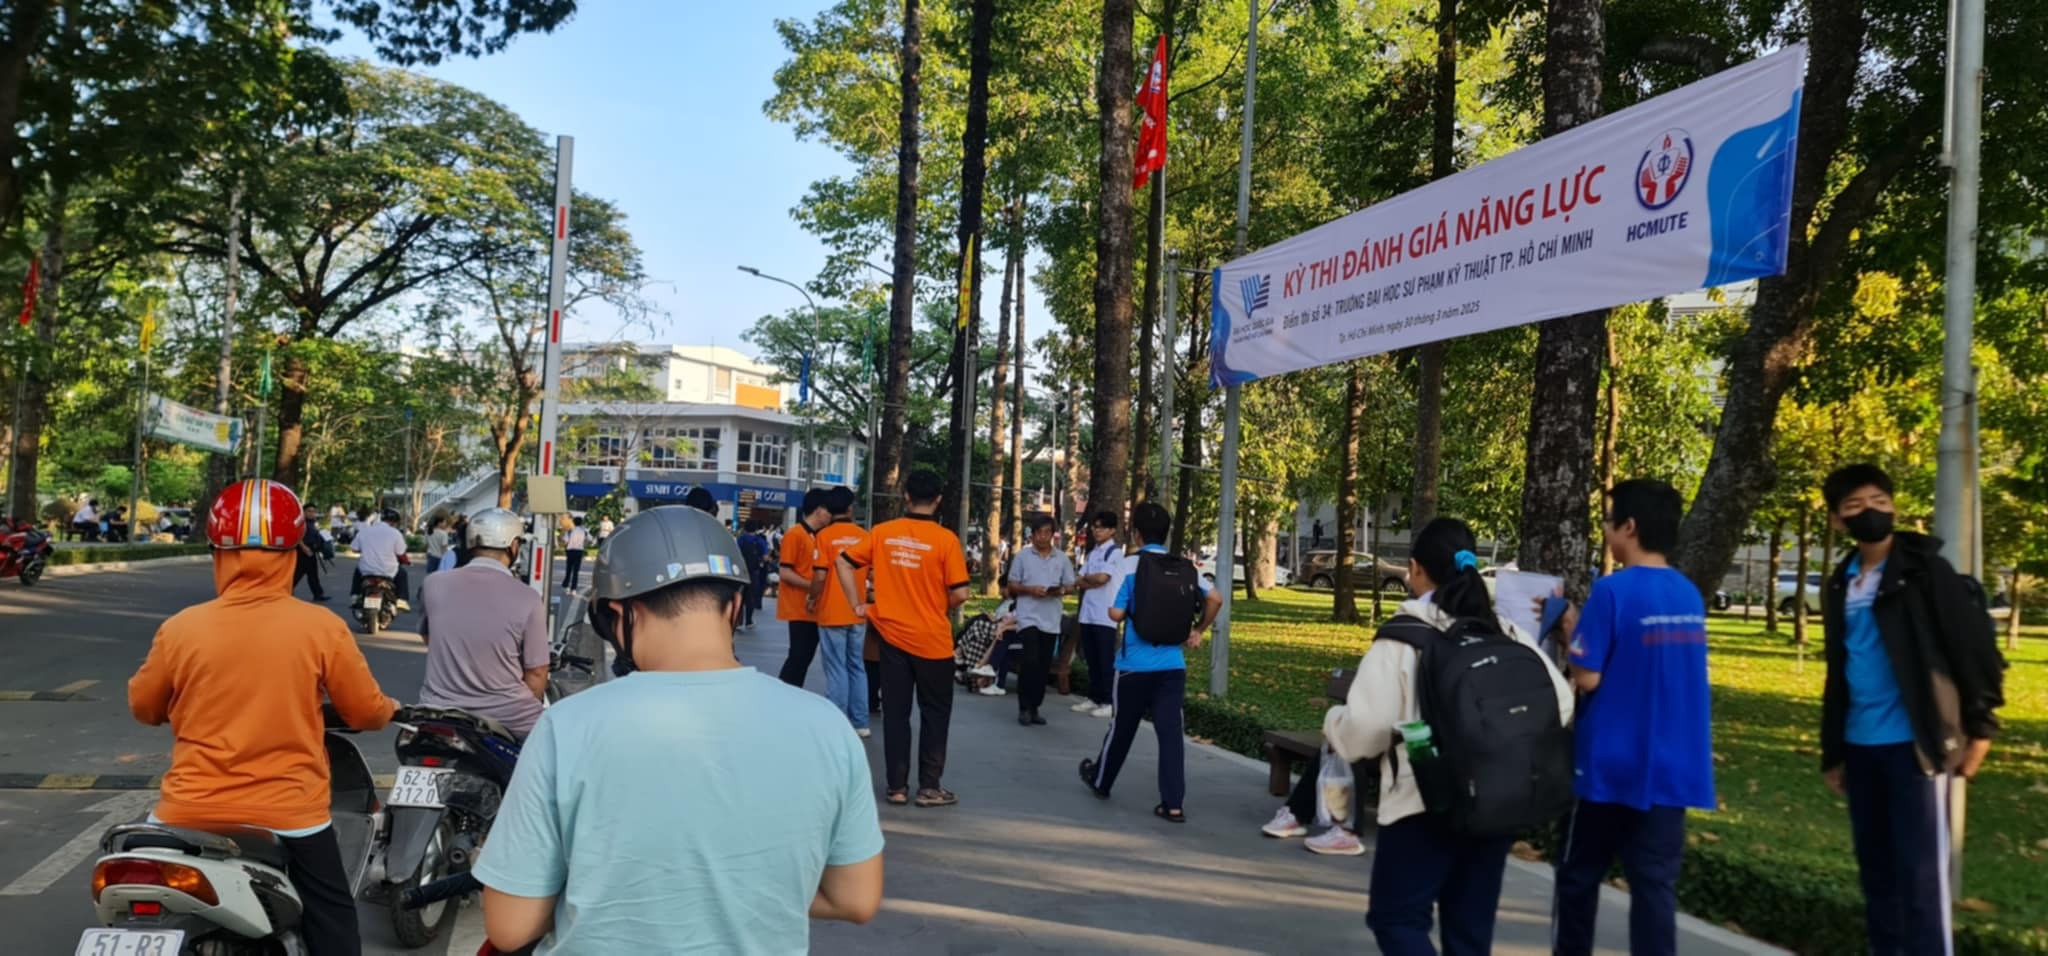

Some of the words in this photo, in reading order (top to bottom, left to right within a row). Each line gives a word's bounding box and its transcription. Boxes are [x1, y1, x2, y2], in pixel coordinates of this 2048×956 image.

[1309, 255, 1339, 290] THI
[1342, 232, 1404, 280] ĐÁNH
[1408, 210, 1448, 259] GIÁ
[1455, 188, 1535, 246] NĂNG
[1541, 164, 1606, 223] LỰC
[1625, 211, 1689, 243] HCMUTE
[1383, 282, 1401, 304] HỌC
[1402, 275, 1417, 298] SƯ
[1417, 270, 1445, 294] PHẠM
[1464, 253, 1497, 281] THUẬT
[1500, 251, 1515, 272] TP.
[1518, 240, 1534, 267] HỒ
[1538, 234, 1559, 262] CHÍ
[1561, 228, 1594, 256] MINH
[1404, 316, 1413, 328] 30
[1413, 311, 1435, 326] tháng
[1435, 310, 1442, 321] 3
[1442, 306, 1460, 320] năm
[1460, 300, 1481, 316] 2025
